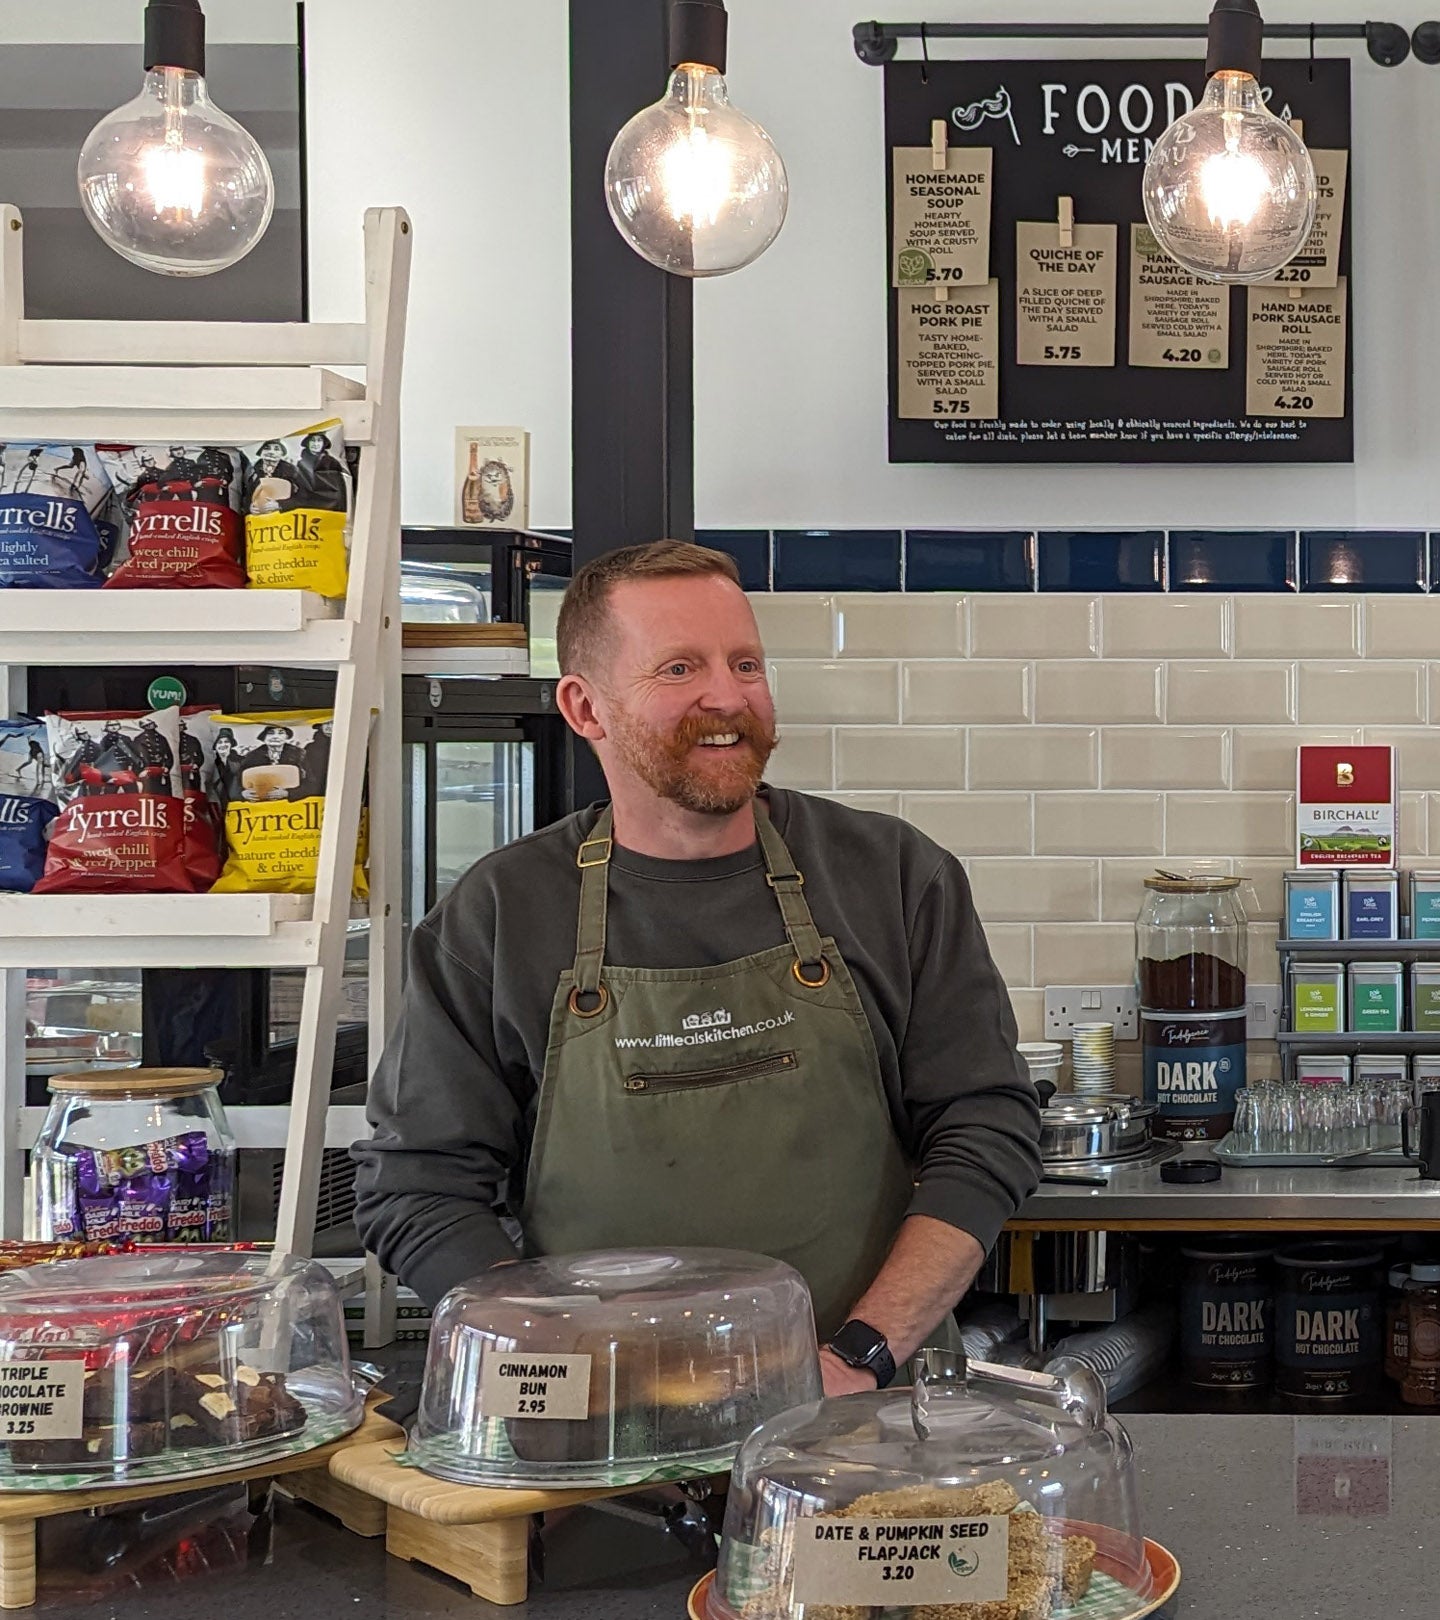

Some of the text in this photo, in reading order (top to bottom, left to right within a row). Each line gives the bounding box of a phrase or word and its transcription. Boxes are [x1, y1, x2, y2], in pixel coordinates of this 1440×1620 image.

[905, 173, 984, 184] HOMEMADE
[909, 185, 980, 196] SEASONAL
[926, 198, 963, 208] SOUP
[924, 211, 961, 219] HEARTY
[913, 220, 970, 228] HOMEMADE
[909, 228, 975, 237] SOUP SERVED
[905, 238, 931, 247] WITH
[942, 237, 978, 245] CRUSTY
[1029, 248, 1103, 261] QUICHE OF
[1036, 261, 1095, 273] THE DAY
[926, 268, 963, 281] 5.70
[1139, 276, 1192, 285] SAUSAGE
[1274, 269, 1310, 282] 2.20
[911, 304, 990, 314] HOG ROAST
[1261, 302, 1332, 313] HAND MADE
[919, 316, 982, 326] PORK PIE
[1251, 312, 1340, 324] PORK SAUSAGE
[1281, 324, 1312, 334] ROLL
[1043, 345, 1081, 359] 5.75
[1162, 349, 1201, 361] 4.20
[932, 399, 970, 413] 5.75
[1273, 395, 1313, 409] 4.20
[167, 547, 199, 558] chilli
[13, 555, 48, 565] salted
[137, 559, 157, 569] red
[273, 557, 318, 569] cheddar
[256, 572, 294, 584] & chive
[152, 687, 182, 701] YUM!
[1314, 810, 1379, 820] BIRCHALL
[227, 802, 324, 845] Tyrrell
[115, 844, 149, 855] chilli
[85, 858, 157, 871] red pepper
[257, 861, 304, 873] & chive
[615, 1010, 795, 1049] www.littlealskitchen.co.uk
[1158, 1061, 1218, 1091] DARK
[1158, 1092, 1218, 1103] HOT CHOCOLATE
[120, 1218, 162, 1230] Freddo
[169, 1212, 205, 1225] Freddo
[1202, 1300, 1265, 1332] DARK
[1296, 1309, 1360, 1342] DARK
[1202, 1332, 1264, 1345] HOT CHOCOLATE
[1296, 1343, 1359, 1355] HOT CHOCOLATE
[1, 1367, 49, 1382] TRIPLE
[498, 1363, 568, 1379] CINNAMON
[518, 1381, 547, 1396] BUN
[517, 1400, 546, 1414] 2.95
[6, 1420, 36, 1435] 3.25
[815, 1522, 989, 1541] DATE & PUMPKIN SEED
[858, 1545, 941, 1562] FLAPJACK
[882, 1565, 914, 1580] 3.20
